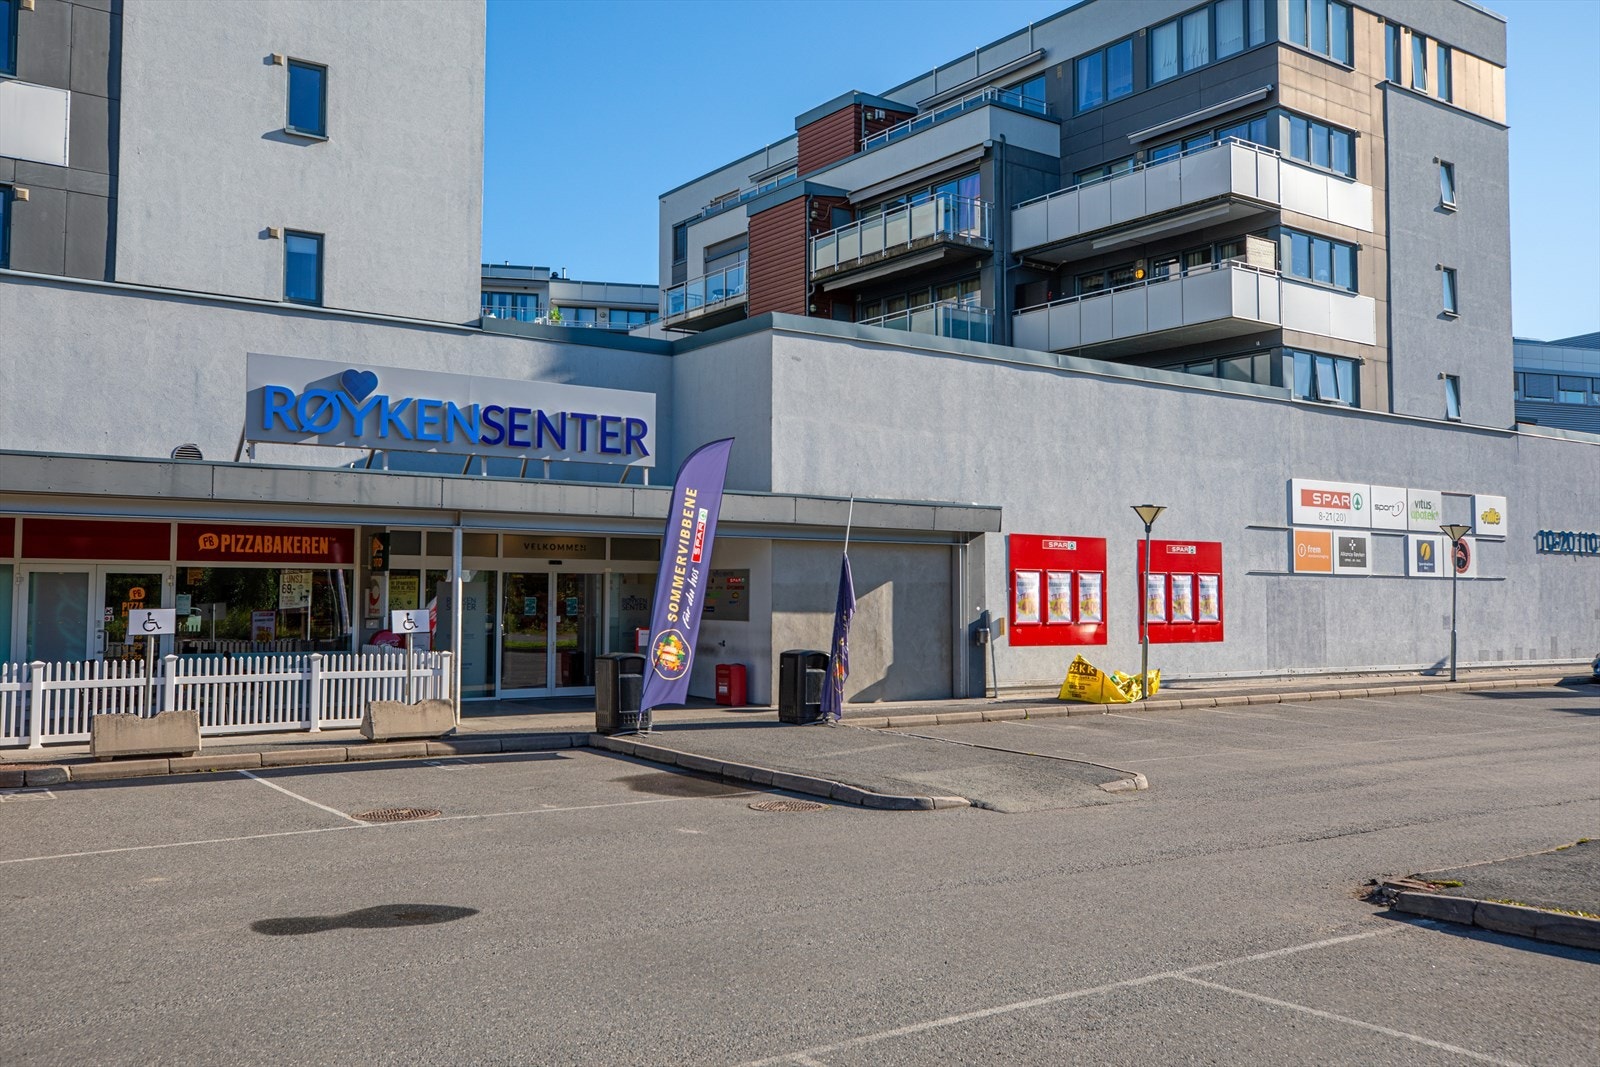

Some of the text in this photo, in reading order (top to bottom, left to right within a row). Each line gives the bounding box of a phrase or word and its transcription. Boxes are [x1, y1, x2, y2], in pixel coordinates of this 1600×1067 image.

[263, 384, 650, 457] RØYKENSENTER
[1312, 492, 1350, 506] SPAR
[1414, 500, 1432, 509] vitus
[220, 534, 329, 555] PIZZABAKEREN
[523, 542, 587, 552] VELKOMMEN
[693, 521, 705, 556] SPAR
[667, 487, 698, 622] SOMMERVIBBENE
[687, 567, 700, 588] hos
[121, 602, 144, 611] PIZZA
[621, 603, 648, 611] SENTER
[685, 588, 695, 608] du
